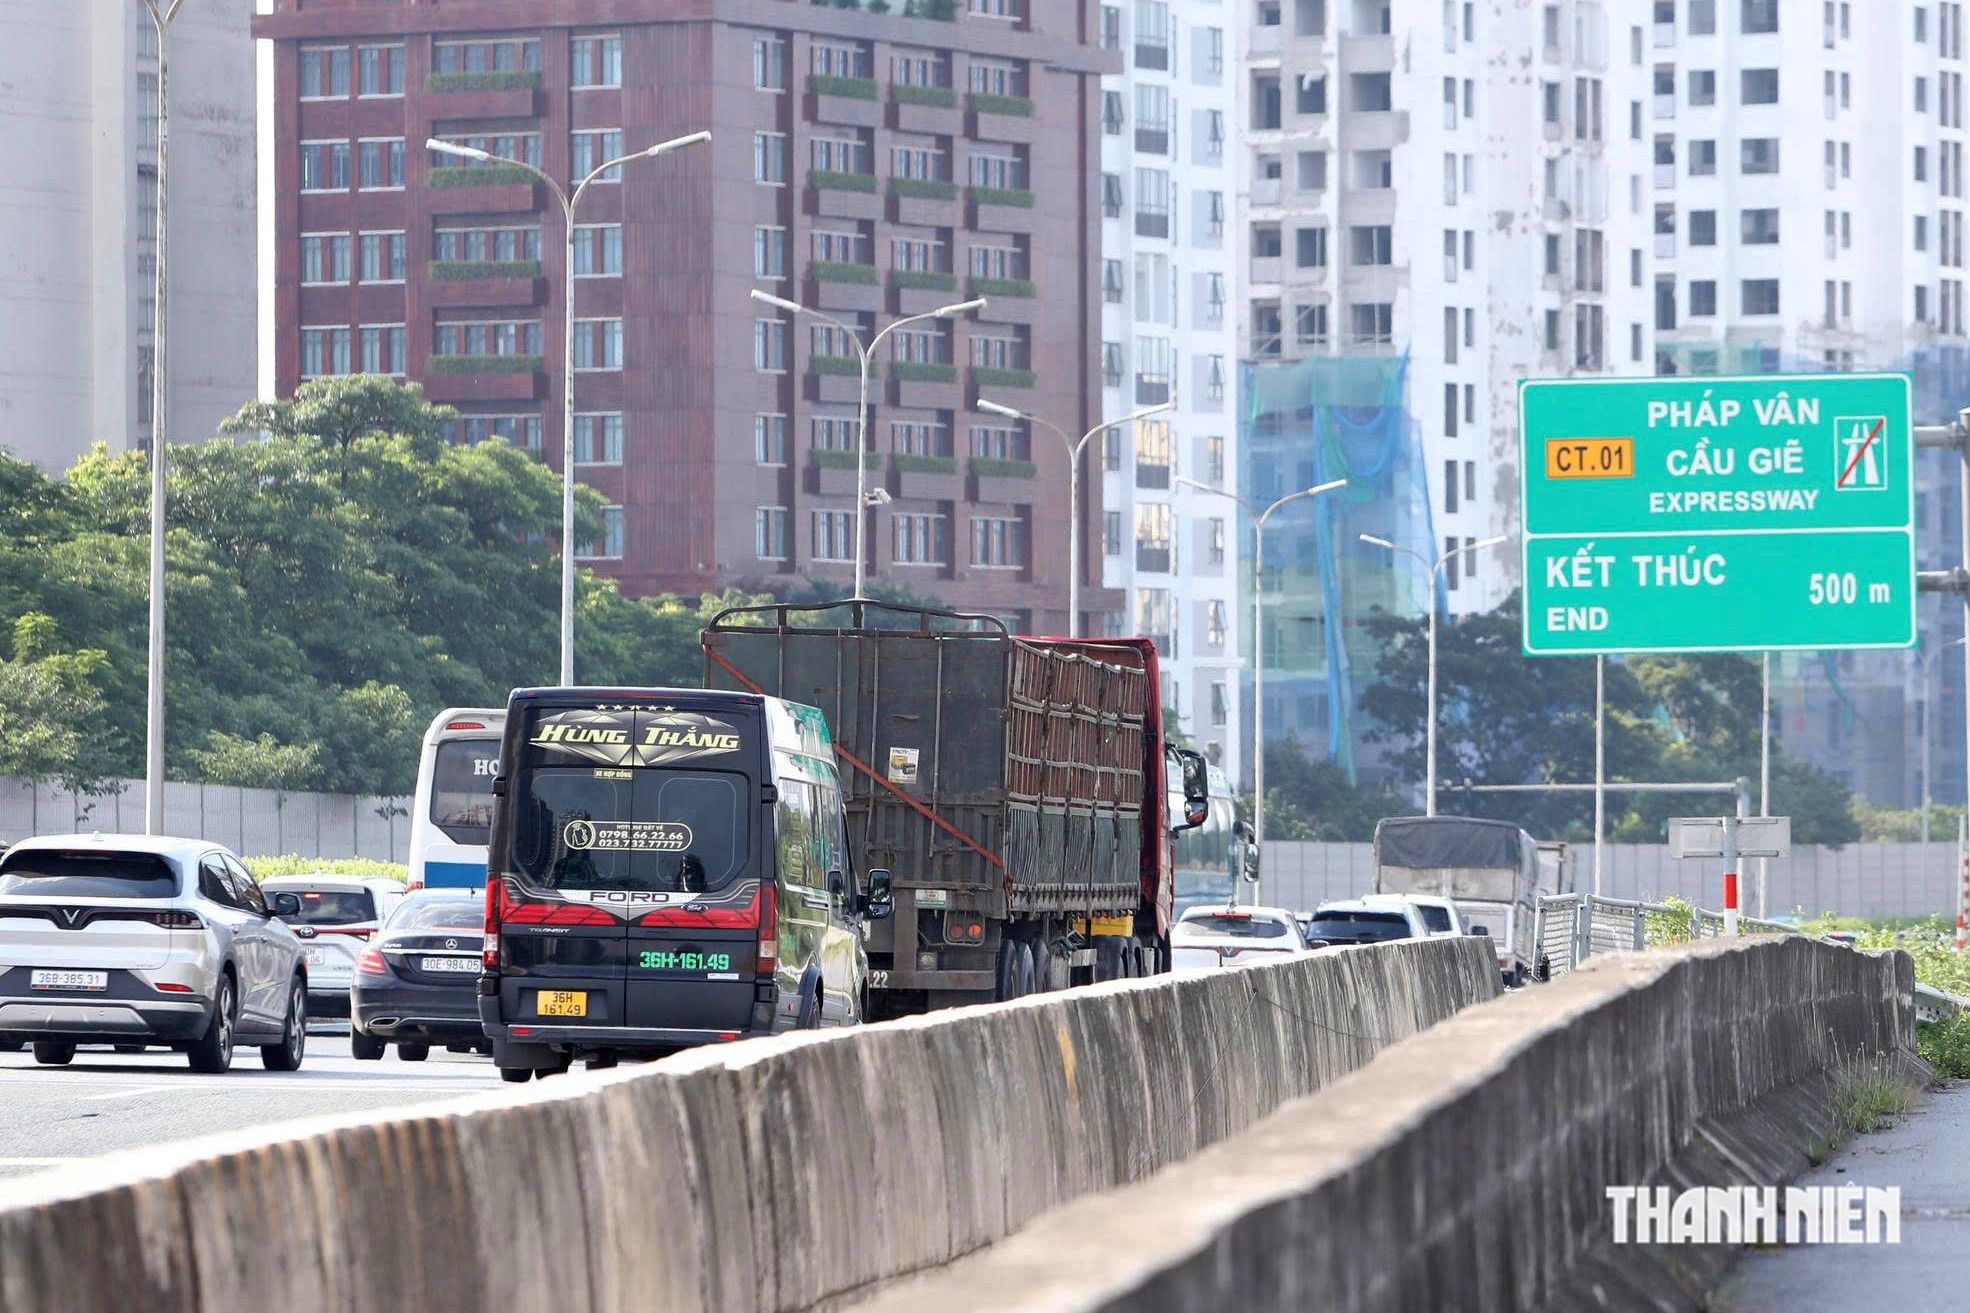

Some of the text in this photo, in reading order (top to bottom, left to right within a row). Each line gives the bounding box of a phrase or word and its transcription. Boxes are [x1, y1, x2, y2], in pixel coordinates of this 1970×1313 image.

[1647, 390, 1820, 428] PHÁP VÂN
[1556, 444, 1624, 472] CT.01
[1666, 437, 1805, 476] CẦU GIẼ
[1649, 489, 1819, 514] EXPRESSWAY
[1546, 542, 1726, 588] KẾT THÚC
[1808, 573, 1890, 605] 500 m
[1547, 607, 1609, 633] END
[530, 724, 740, 749] HÙNG THẮNG
[598, 839, 683, 849] 023.732.77777
[599, 830, 684, 841] 0798.66.22.66
[589, 891, 670, 903] FORD
[423, 959, 479, 971] 30E-98405
[639, 951, 730, 971] 36H-161.49
[543, 1004, 581, 1015] 161.49
[552, 992, 573, 1004] 36H
